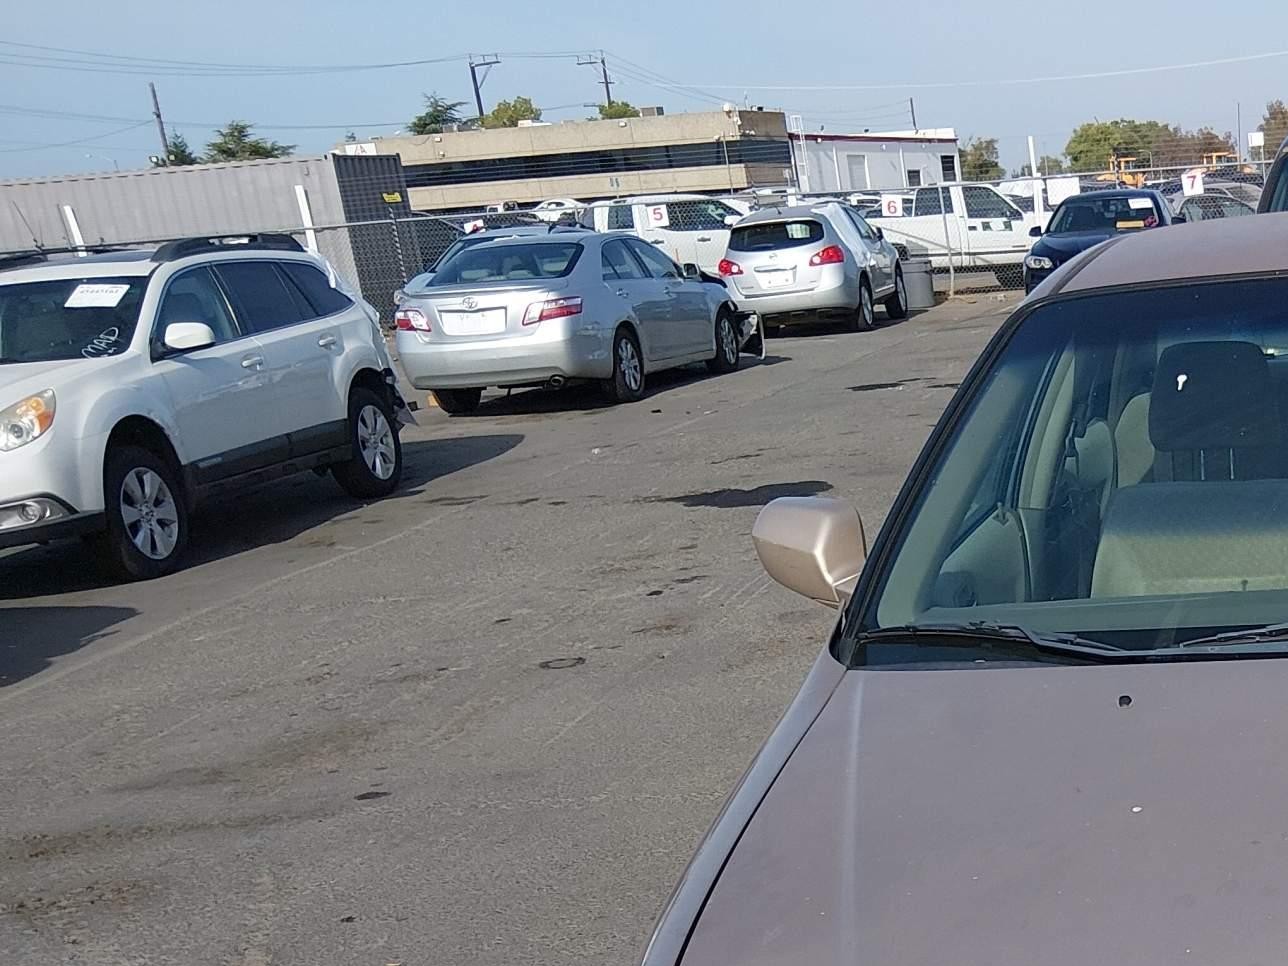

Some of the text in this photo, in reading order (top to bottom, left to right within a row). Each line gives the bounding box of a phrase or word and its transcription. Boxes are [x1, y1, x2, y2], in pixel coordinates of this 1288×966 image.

[1186, 175, 1196, 189] 7
[653, 207, 663, 221] 5
[887, 200, 897, 214] 6
